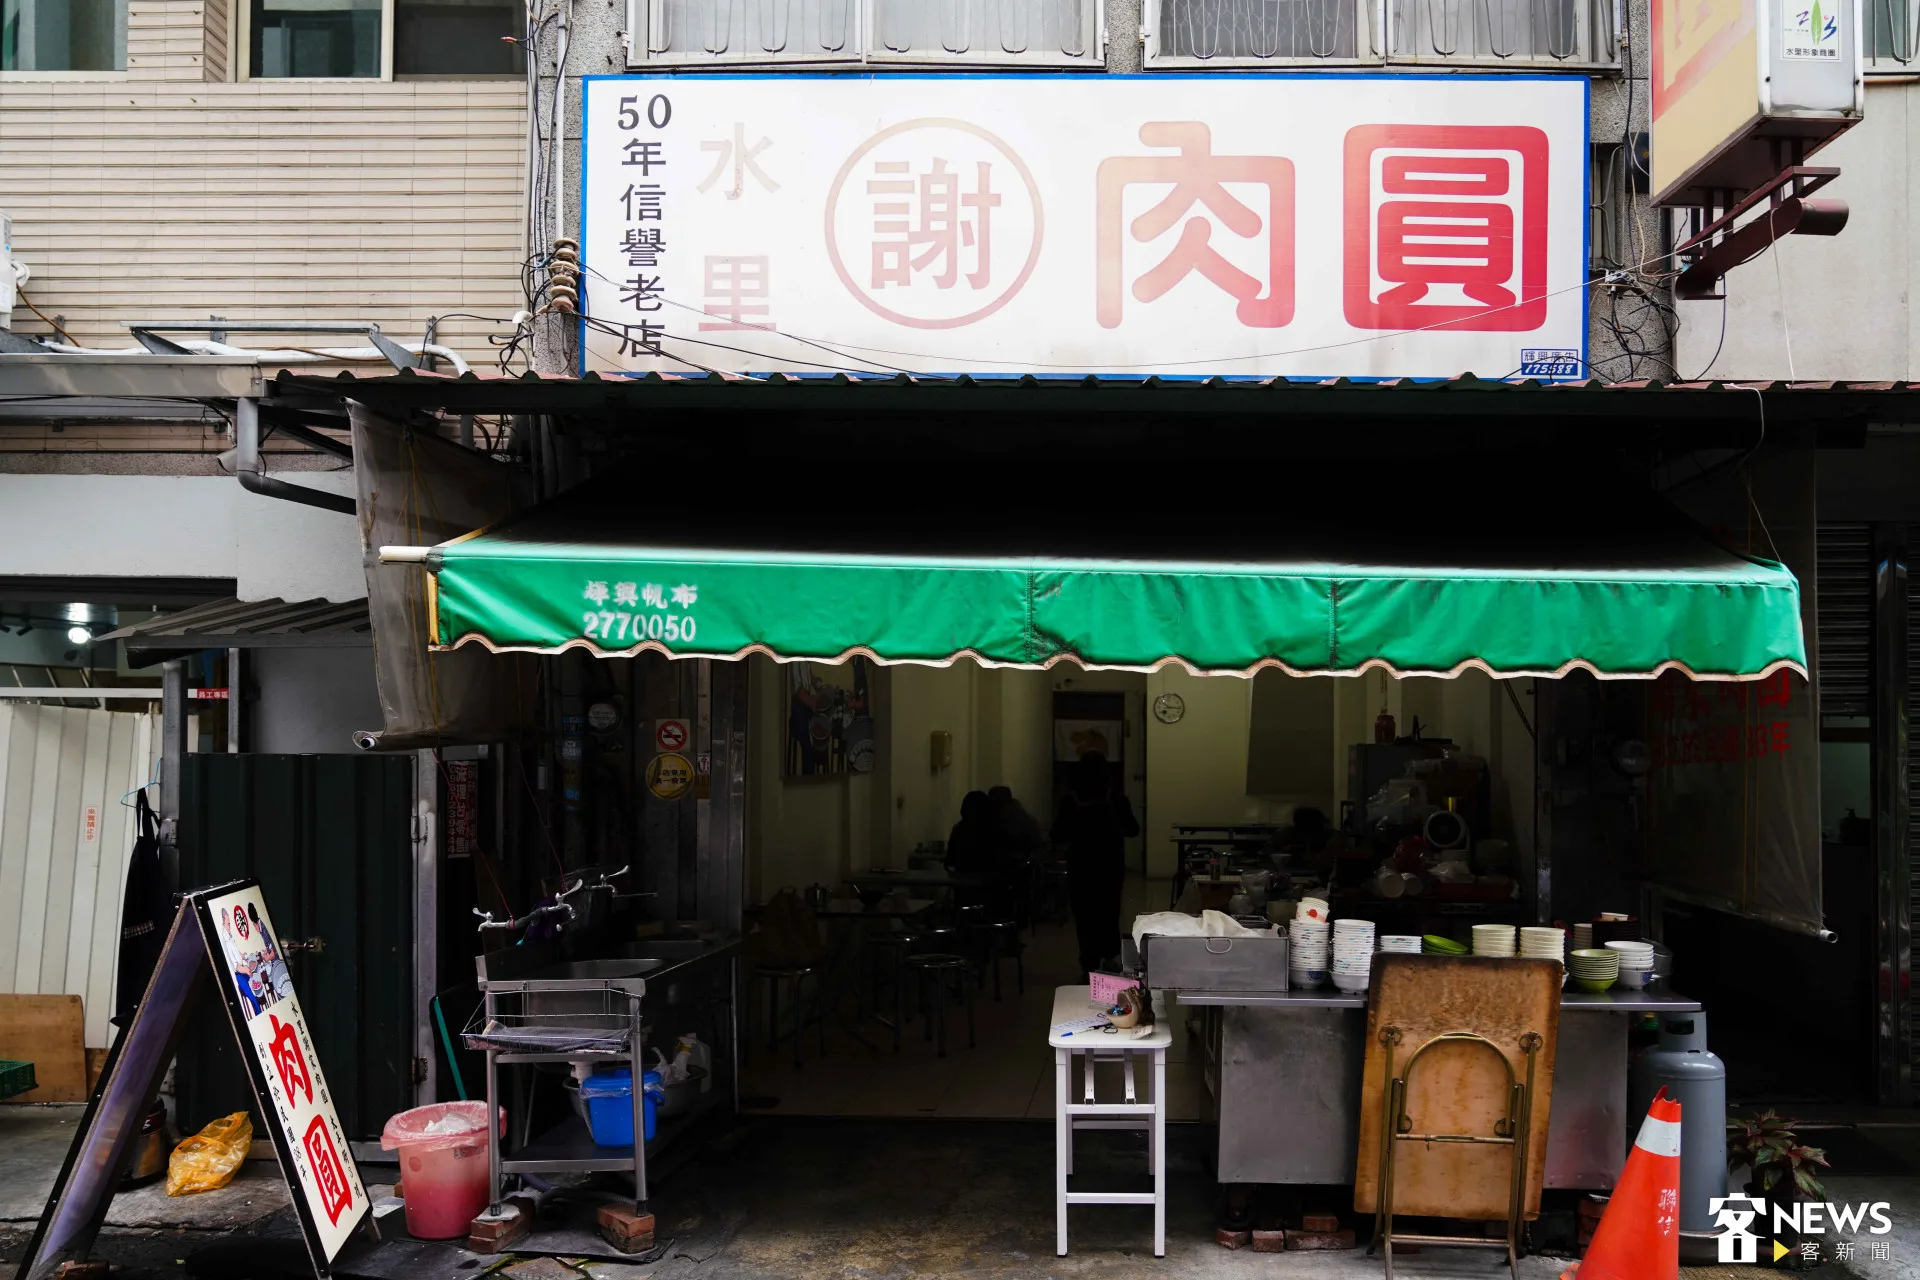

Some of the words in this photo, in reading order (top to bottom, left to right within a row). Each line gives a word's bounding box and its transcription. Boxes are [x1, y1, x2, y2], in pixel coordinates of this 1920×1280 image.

[617, 93, 673, 358] 50年信譽老店
[696, 122, 781, 332] 水里
[866, 156, 1001, 291] 謝
[1096, 121, 1549, 332] 肉圓
[1524, 350, 1575, 363] 輝興廣告
[583, 610, 697, 642] 2770050
[268, 1013, 353, 1228] 肉圓
